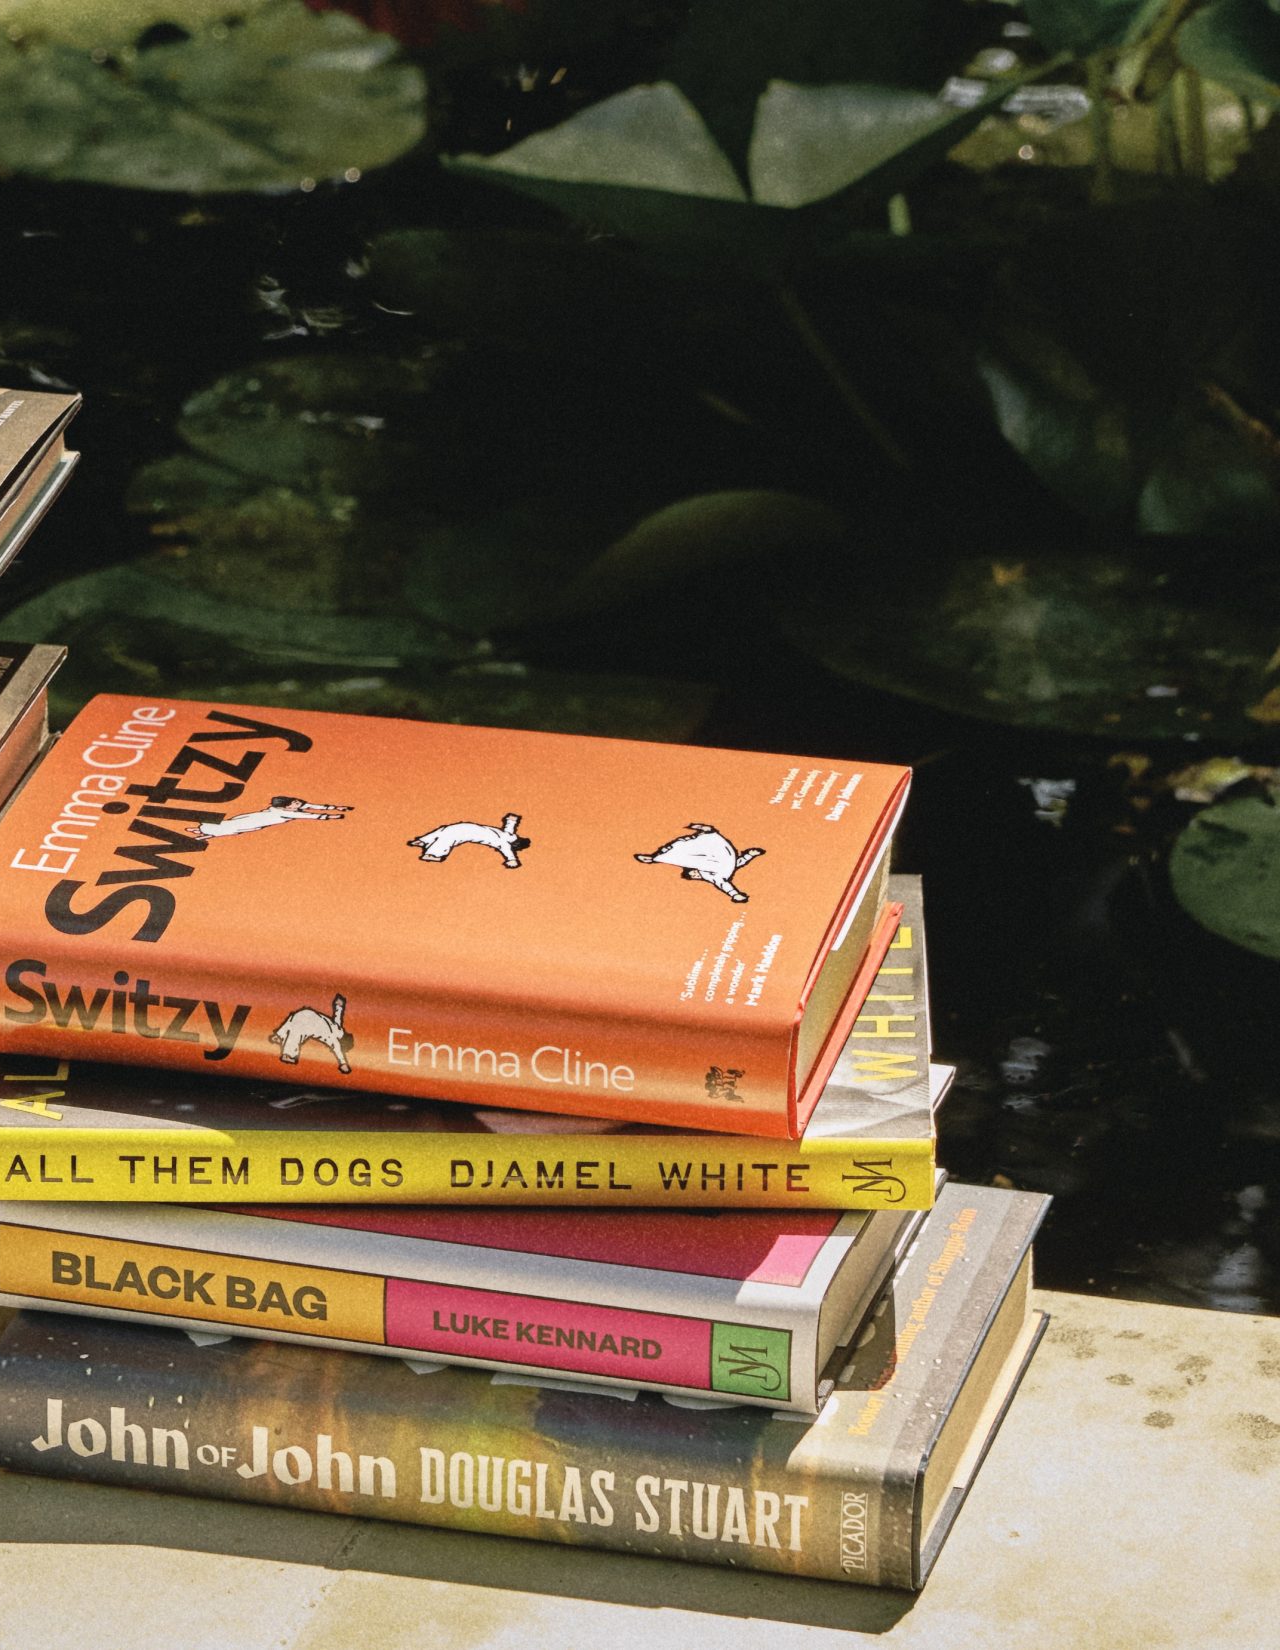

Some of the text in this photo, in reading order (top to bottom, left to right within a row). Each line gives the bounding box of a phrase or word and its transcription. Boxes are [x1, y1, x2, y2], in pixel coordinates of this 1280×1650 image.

[10, 706, 176, 875] Emma Cline
[44, 710, 314, 943] Switzy
[705, 952, 731, 1002] completely
[744, 935, 783, 1006] Mark Haddon
[4, 958, 636, 1092] Switzy Emma Cline
[0, 1060, 70, 1121] AL
[6, 1155, 94, 1184] ALL
[118, 1156, 250, 1186] THEM
[280, 1157, 405, 1188] DOGS
[450, 1159, 632, 1191] DJAMEL
[658, 1161, 811, 1193] WHITE
[51, 1250, 216, 1306] BLACK
[225, 1275, 329, 1321] BAG
[432, 1310, 510, 1341] LUKE
[516, 1321, 663, 1361] KENNARD
[31, 1397, 810, 1552] John OF John DOUGLAS STUART
[841, 1490, 869, 1575] PICADOR
